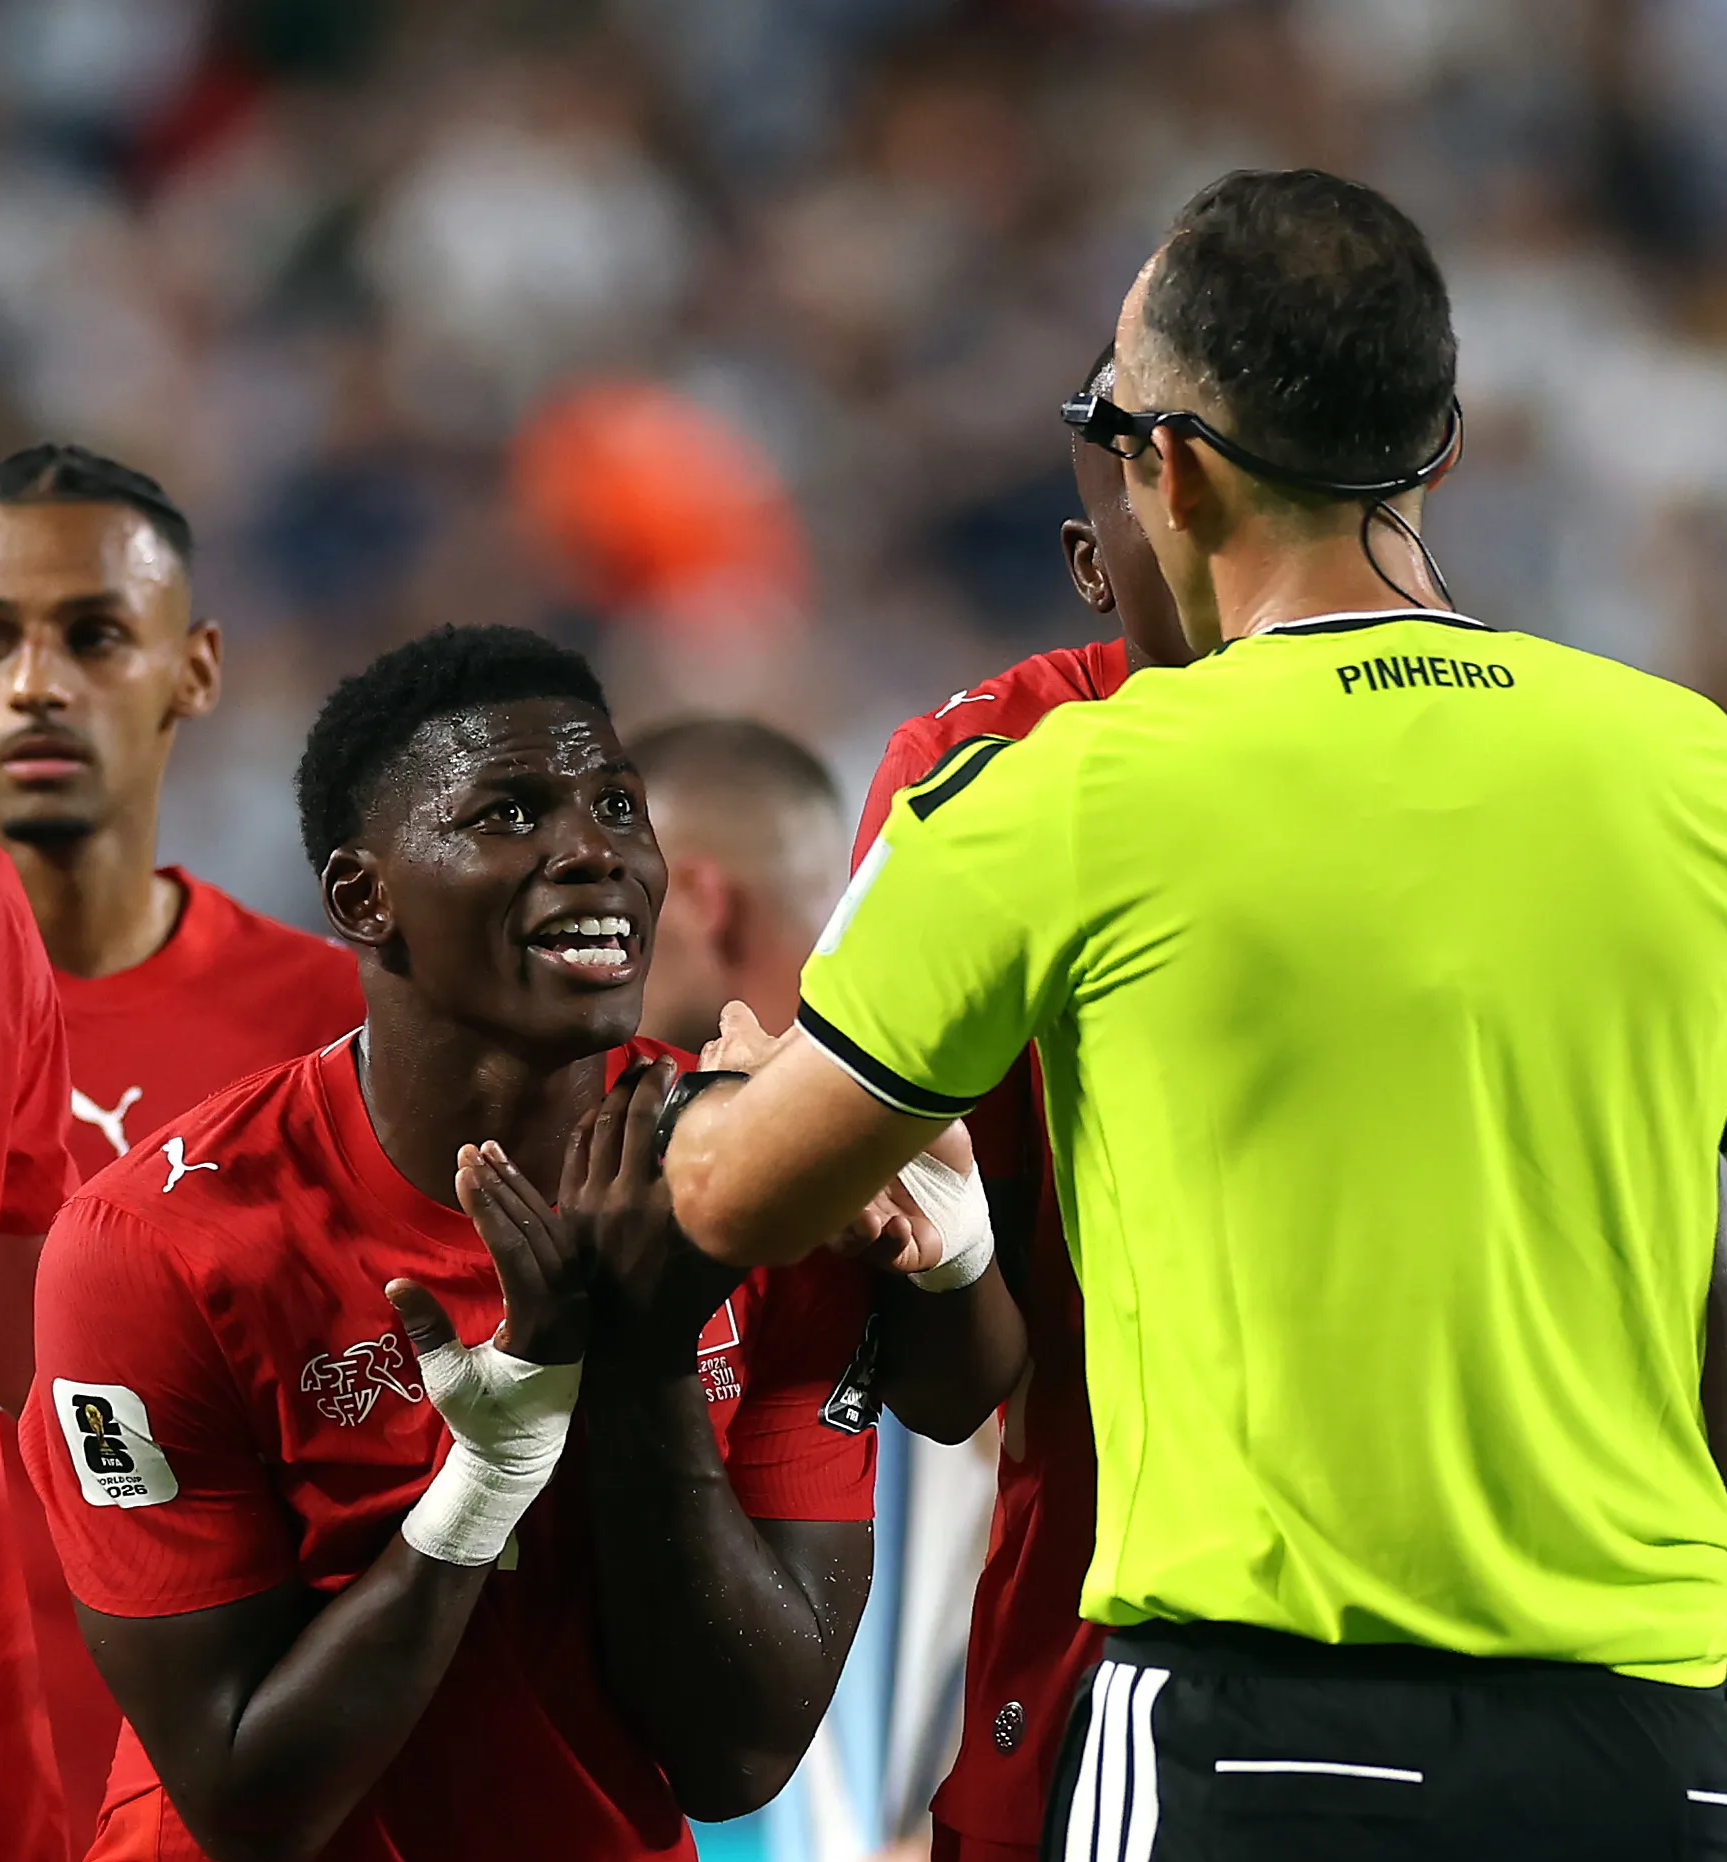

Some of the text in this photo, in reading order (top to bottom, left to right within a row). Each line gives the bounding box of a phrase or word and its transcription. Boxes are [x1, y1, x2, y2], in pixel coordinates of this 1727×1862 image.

[1335, 656, 1515, 695] PINHEIRO
[698, 1356, 727, 1374] .2026
[710, 1367, 735, 1387] SUI
[715, 1383, 742, 1401] CITY
[101, 1457, 123, 1467] FIFA
[97, 1476, 143, 1486] ORLD CUP
[105, 1484, 148, 1499] 026
